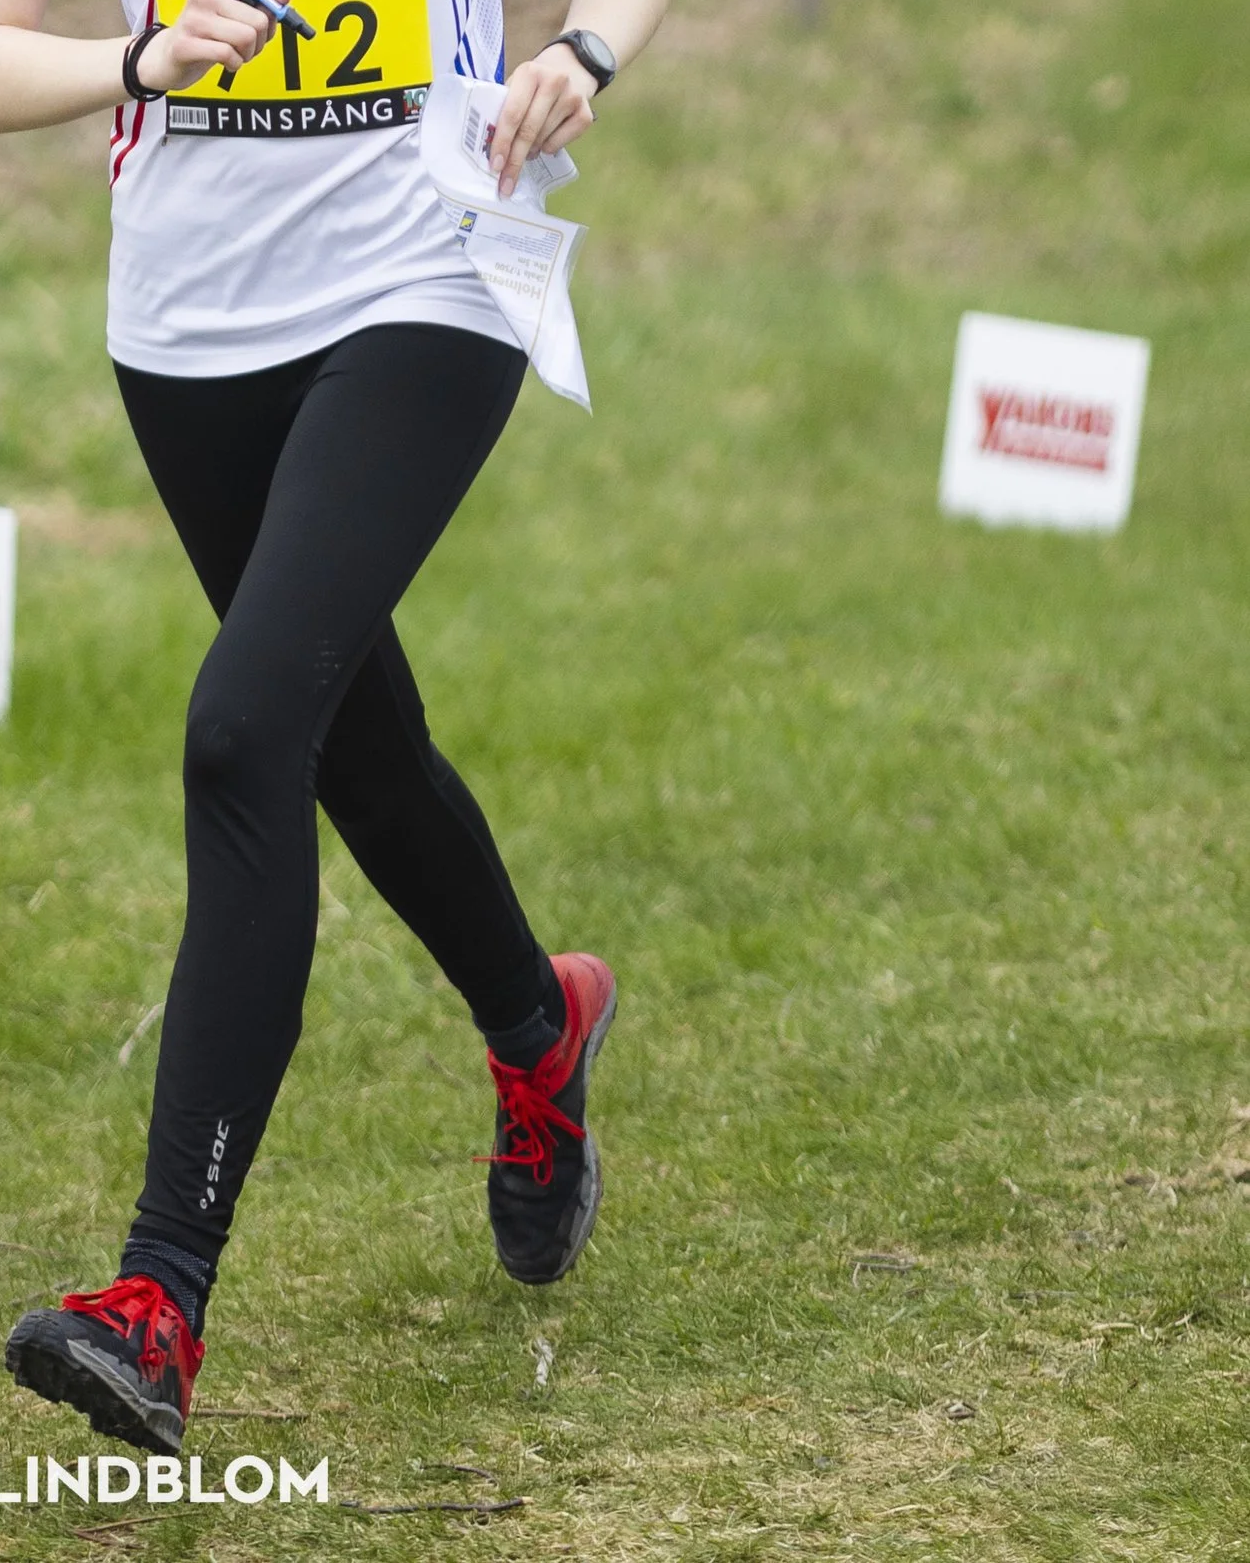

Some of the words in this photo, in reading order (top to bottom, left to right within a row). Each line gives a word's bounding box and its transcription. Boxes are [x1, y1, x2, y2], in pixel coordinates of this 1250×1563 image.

[217, 0, 383, 92] 12
[217, 98, 393, 131] FINSPÅNG
[207, 1119, 230, 1183] SOC
